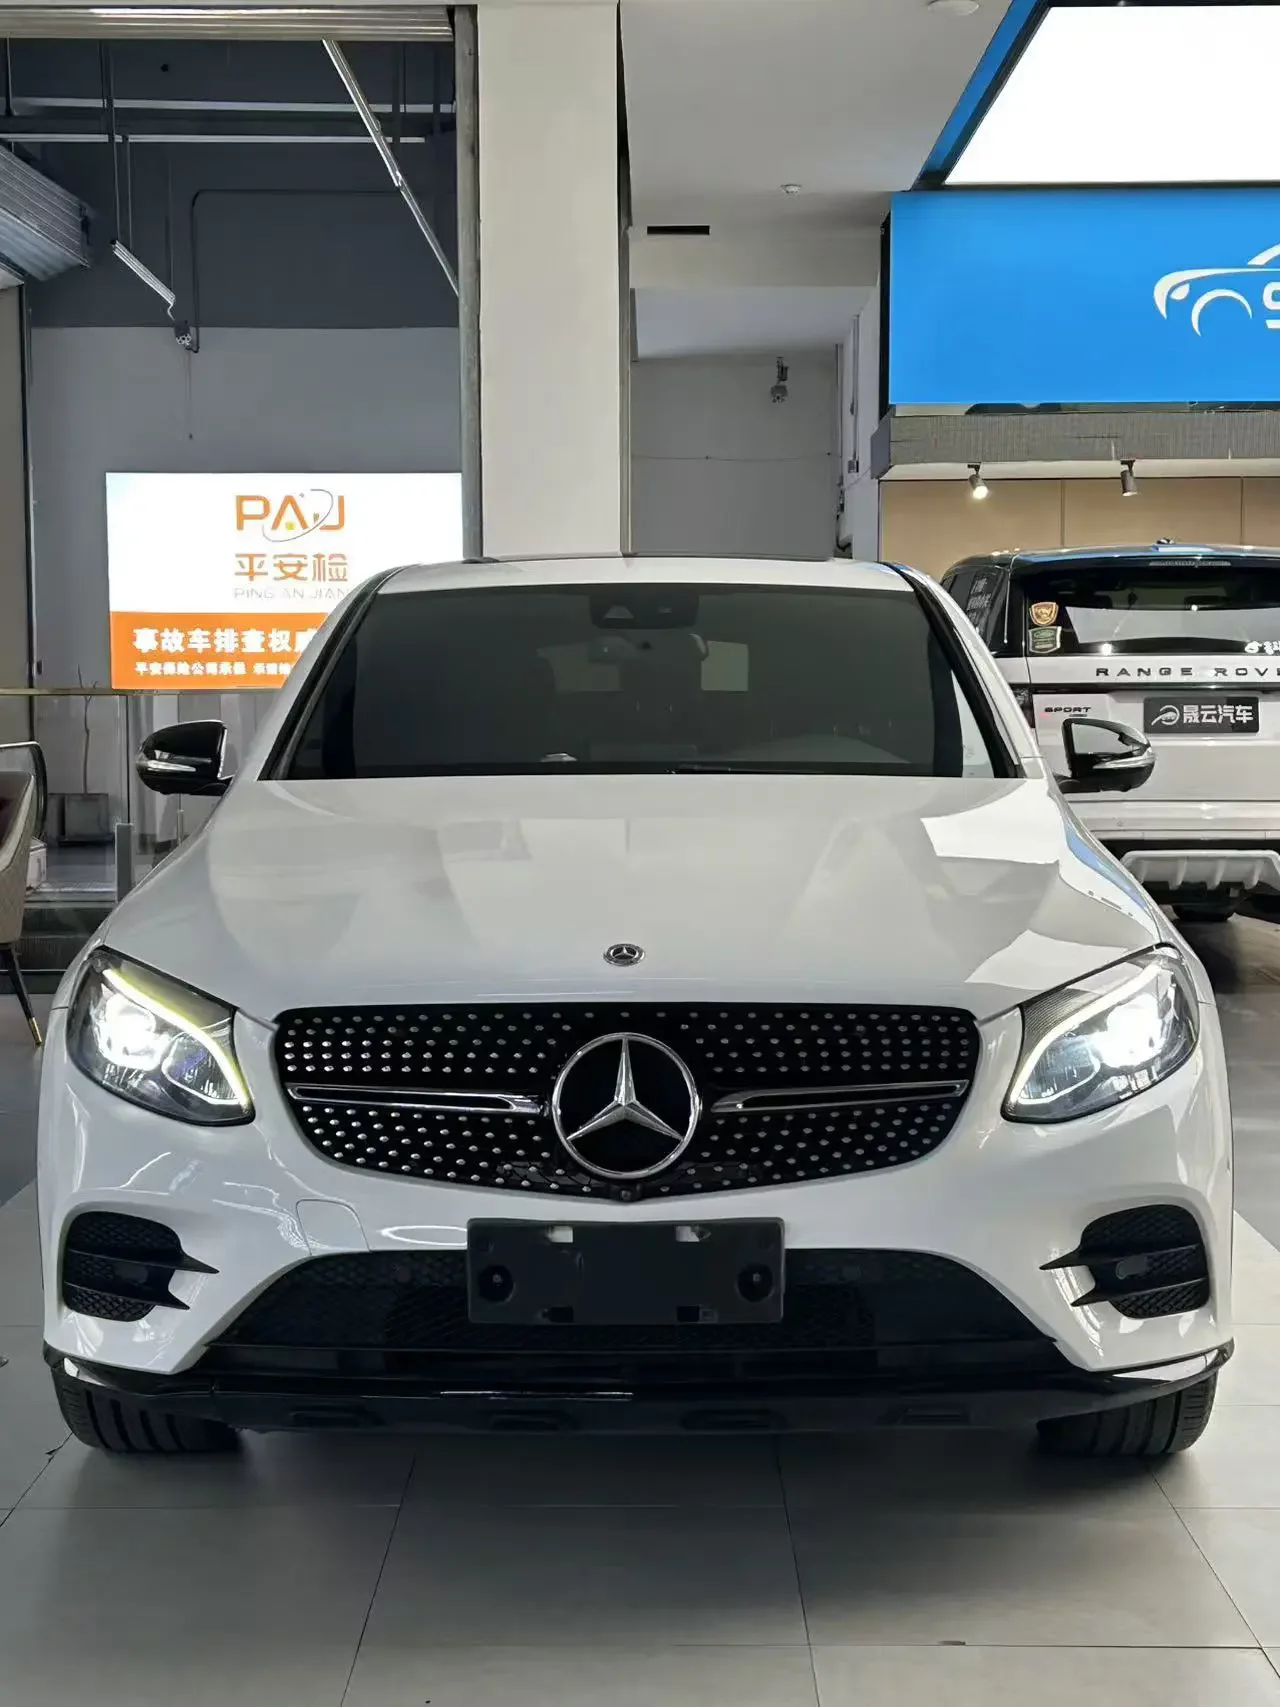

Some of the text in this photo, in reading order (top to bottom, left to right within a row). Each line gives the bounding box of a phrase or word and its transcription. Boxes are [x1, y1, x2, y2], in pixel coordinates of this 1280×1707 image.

[234, 552, 349, 582] 平安检
[234, 587, 274, 600] PING
[283, 587, 305, 600] AN
[1096, 667, 1280, 677] RANGE ROV
[1182, 704, 1254, 724] 晟云汽车
